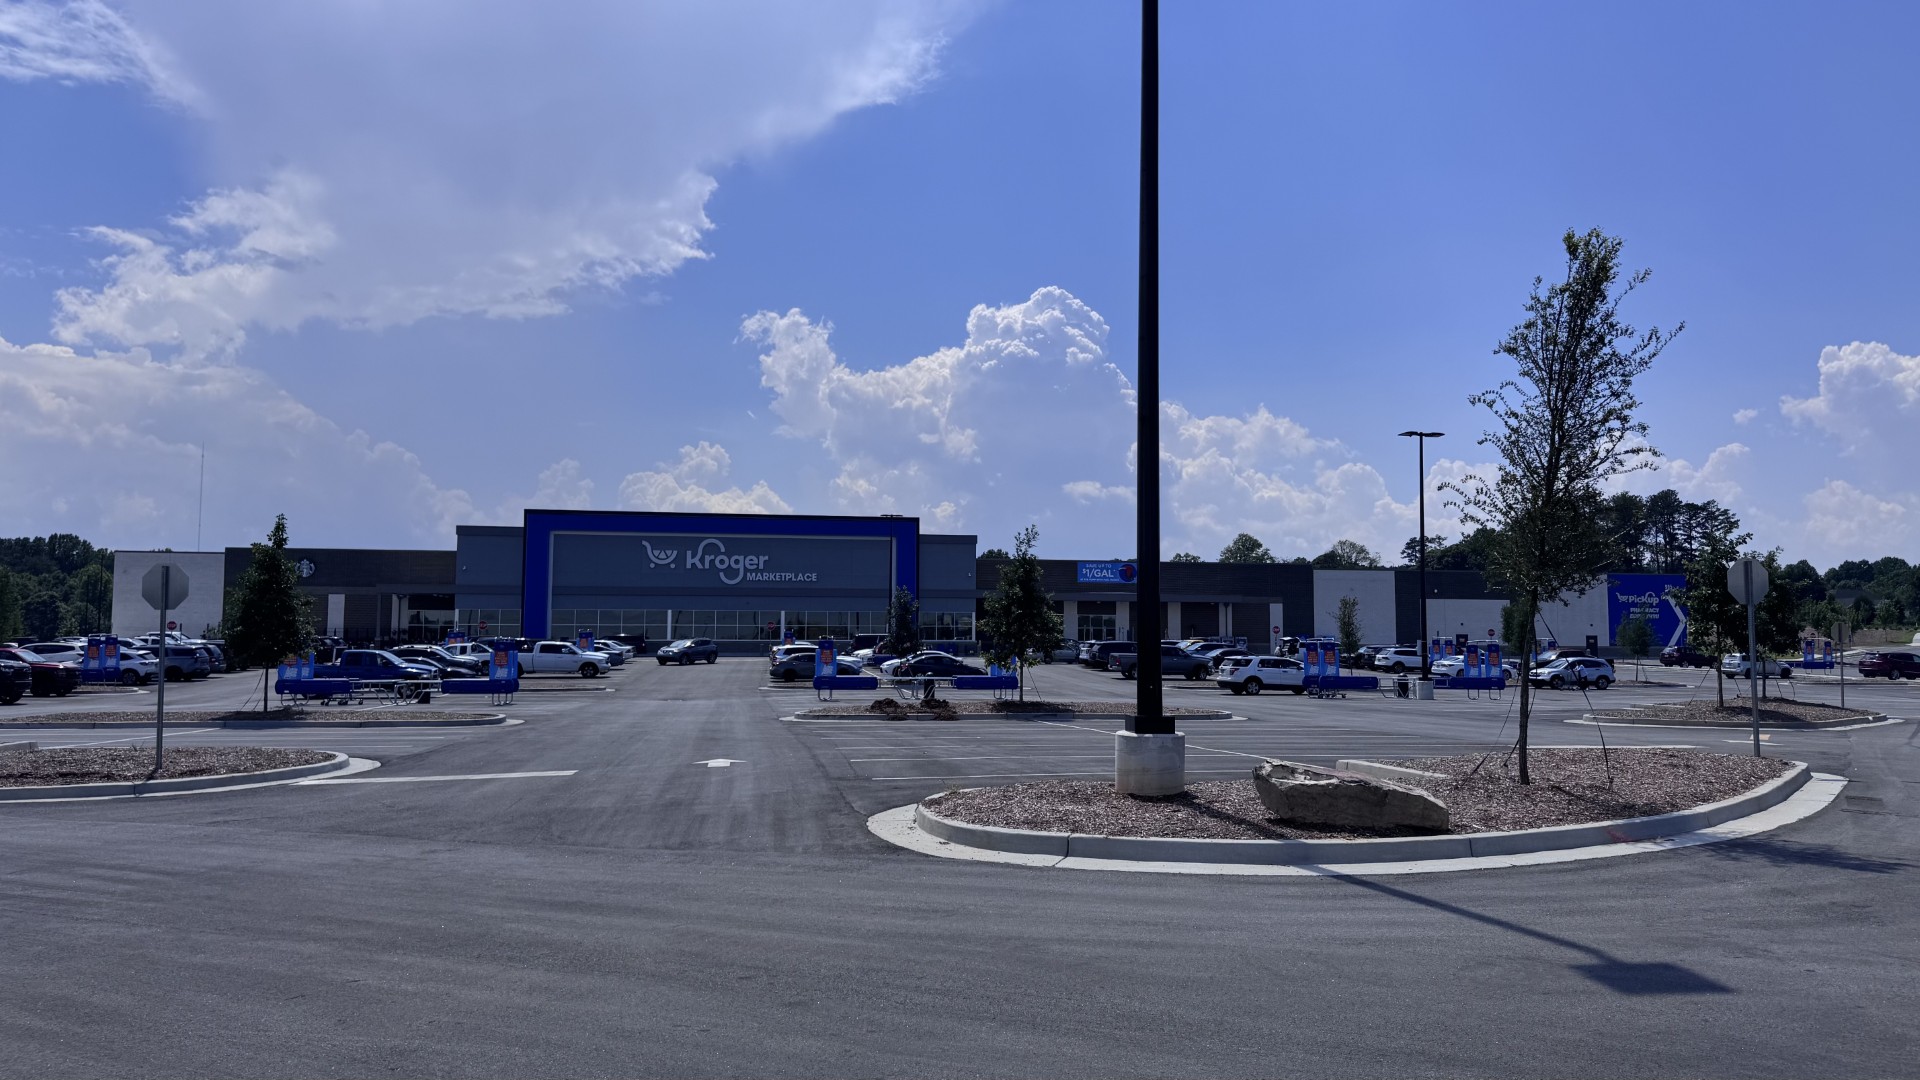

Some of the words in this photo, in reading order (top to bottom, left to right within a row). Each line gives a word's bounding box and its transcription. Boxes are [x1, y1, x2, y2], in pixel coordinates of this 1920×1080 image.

[686, 538, 768, 585] Kroger
[747, 573, 817, 582] MARKETPLACE
[1629, 592, 1659, 606] Pickup
